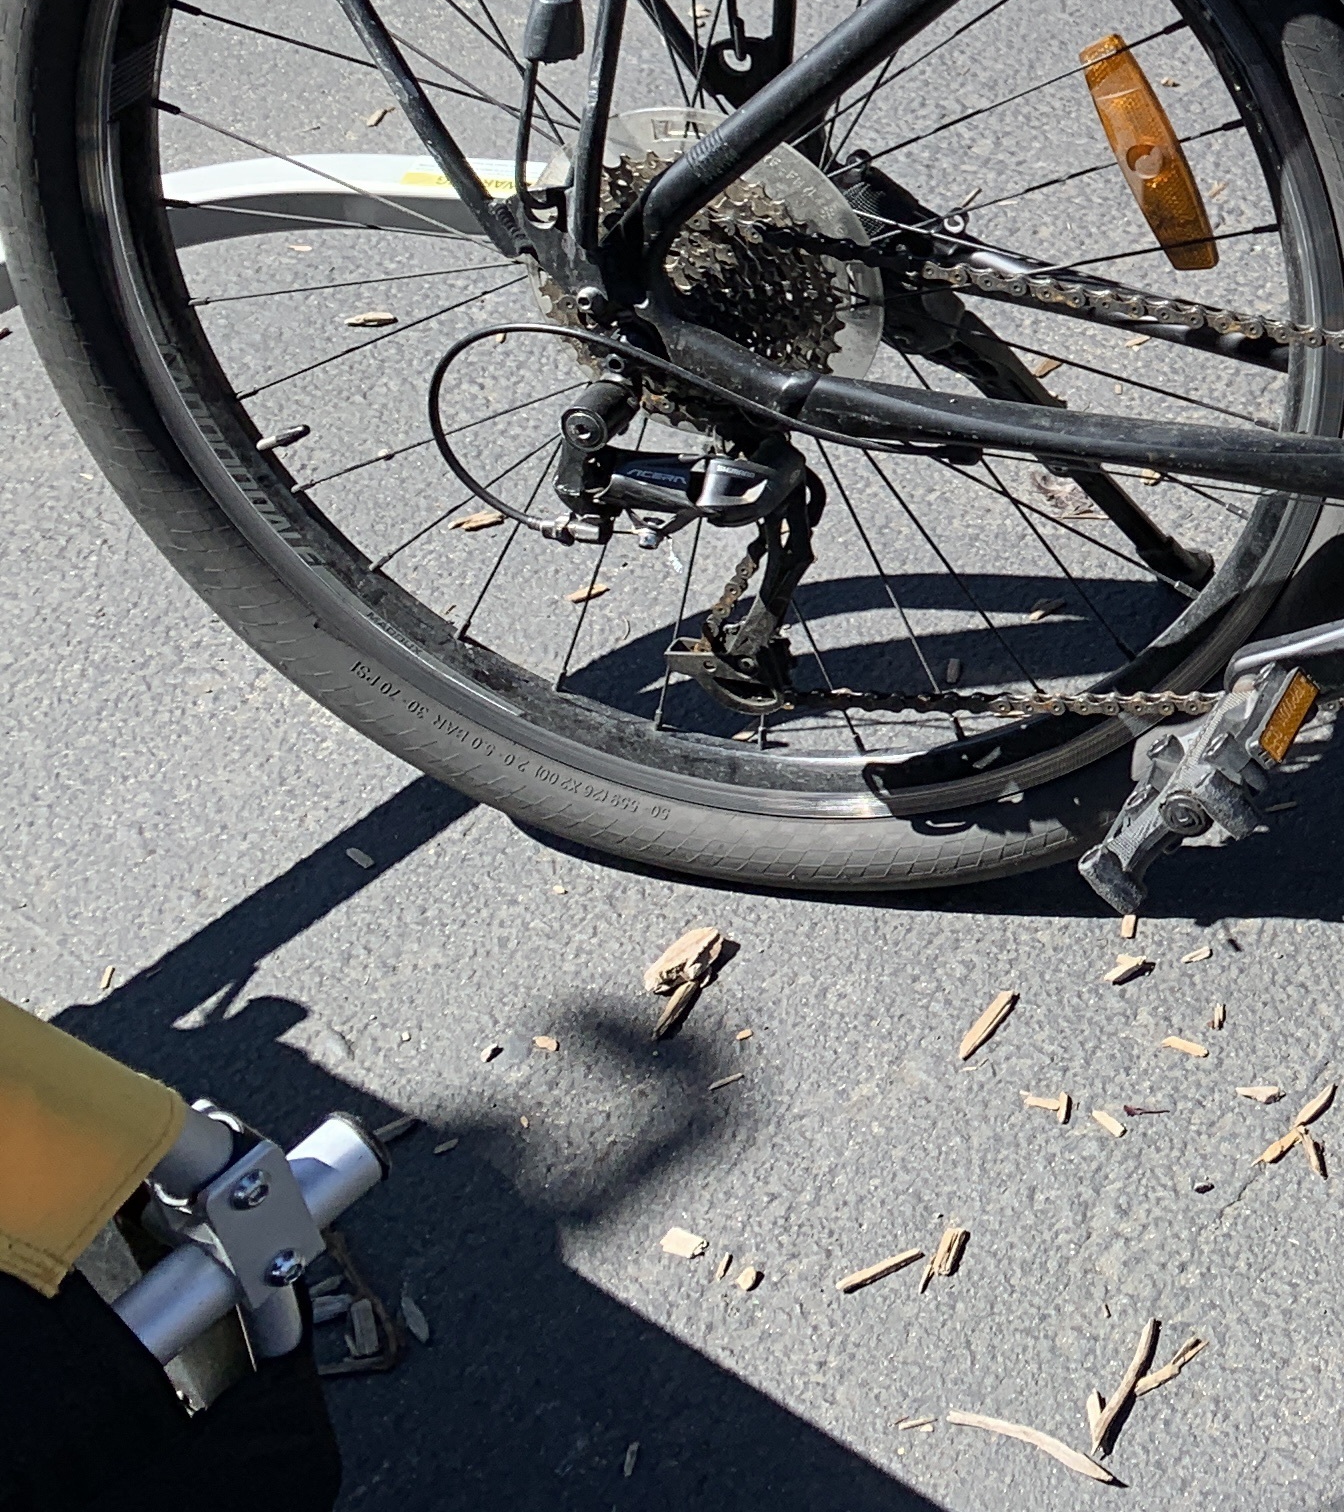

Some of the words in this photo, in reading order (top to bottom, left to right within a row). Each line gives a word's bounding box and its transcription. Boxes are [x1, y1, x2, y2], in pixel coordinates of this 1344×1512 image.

[626, 468, 687, 485] ACERA
[716, 464, 756, 478] SHIMANO
[350, 660, 381, 687] PSI
[432, 714, 470, 743] BAR
